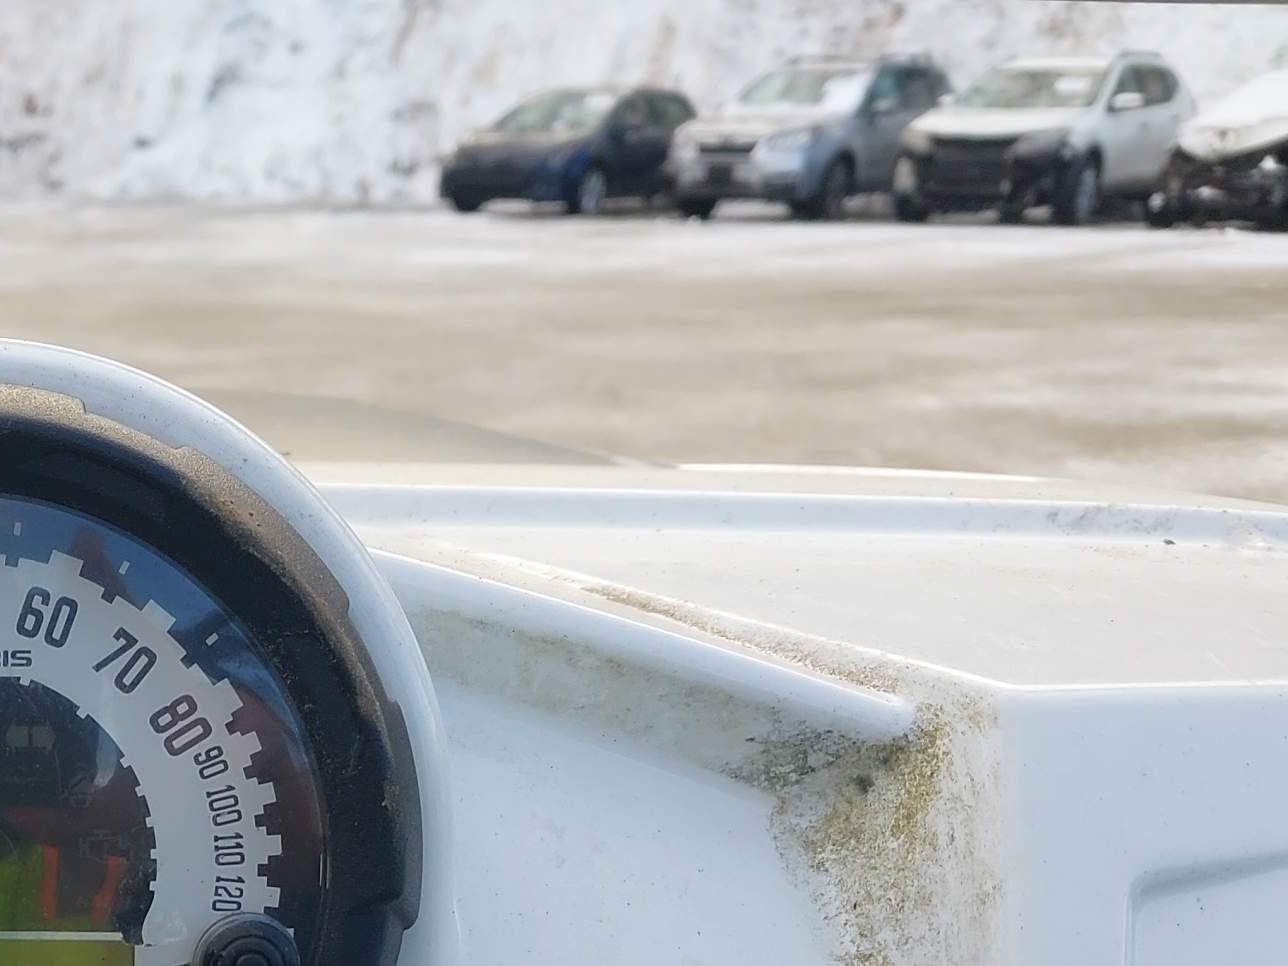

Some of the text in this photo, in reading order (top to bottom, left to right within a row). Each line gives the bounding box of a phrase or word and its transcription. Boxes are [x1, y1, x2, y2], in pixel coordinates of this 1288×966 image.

[16, 586, 78, 649] 60
[92, 627, 157, 694] 70
[148, 694, 213, 757] 80
[193, 745, 229, 780] 90
[206, 784, 243, 827] 100
[213, 832, 246, 867] 110
[211, 875, 246, 912] 120
